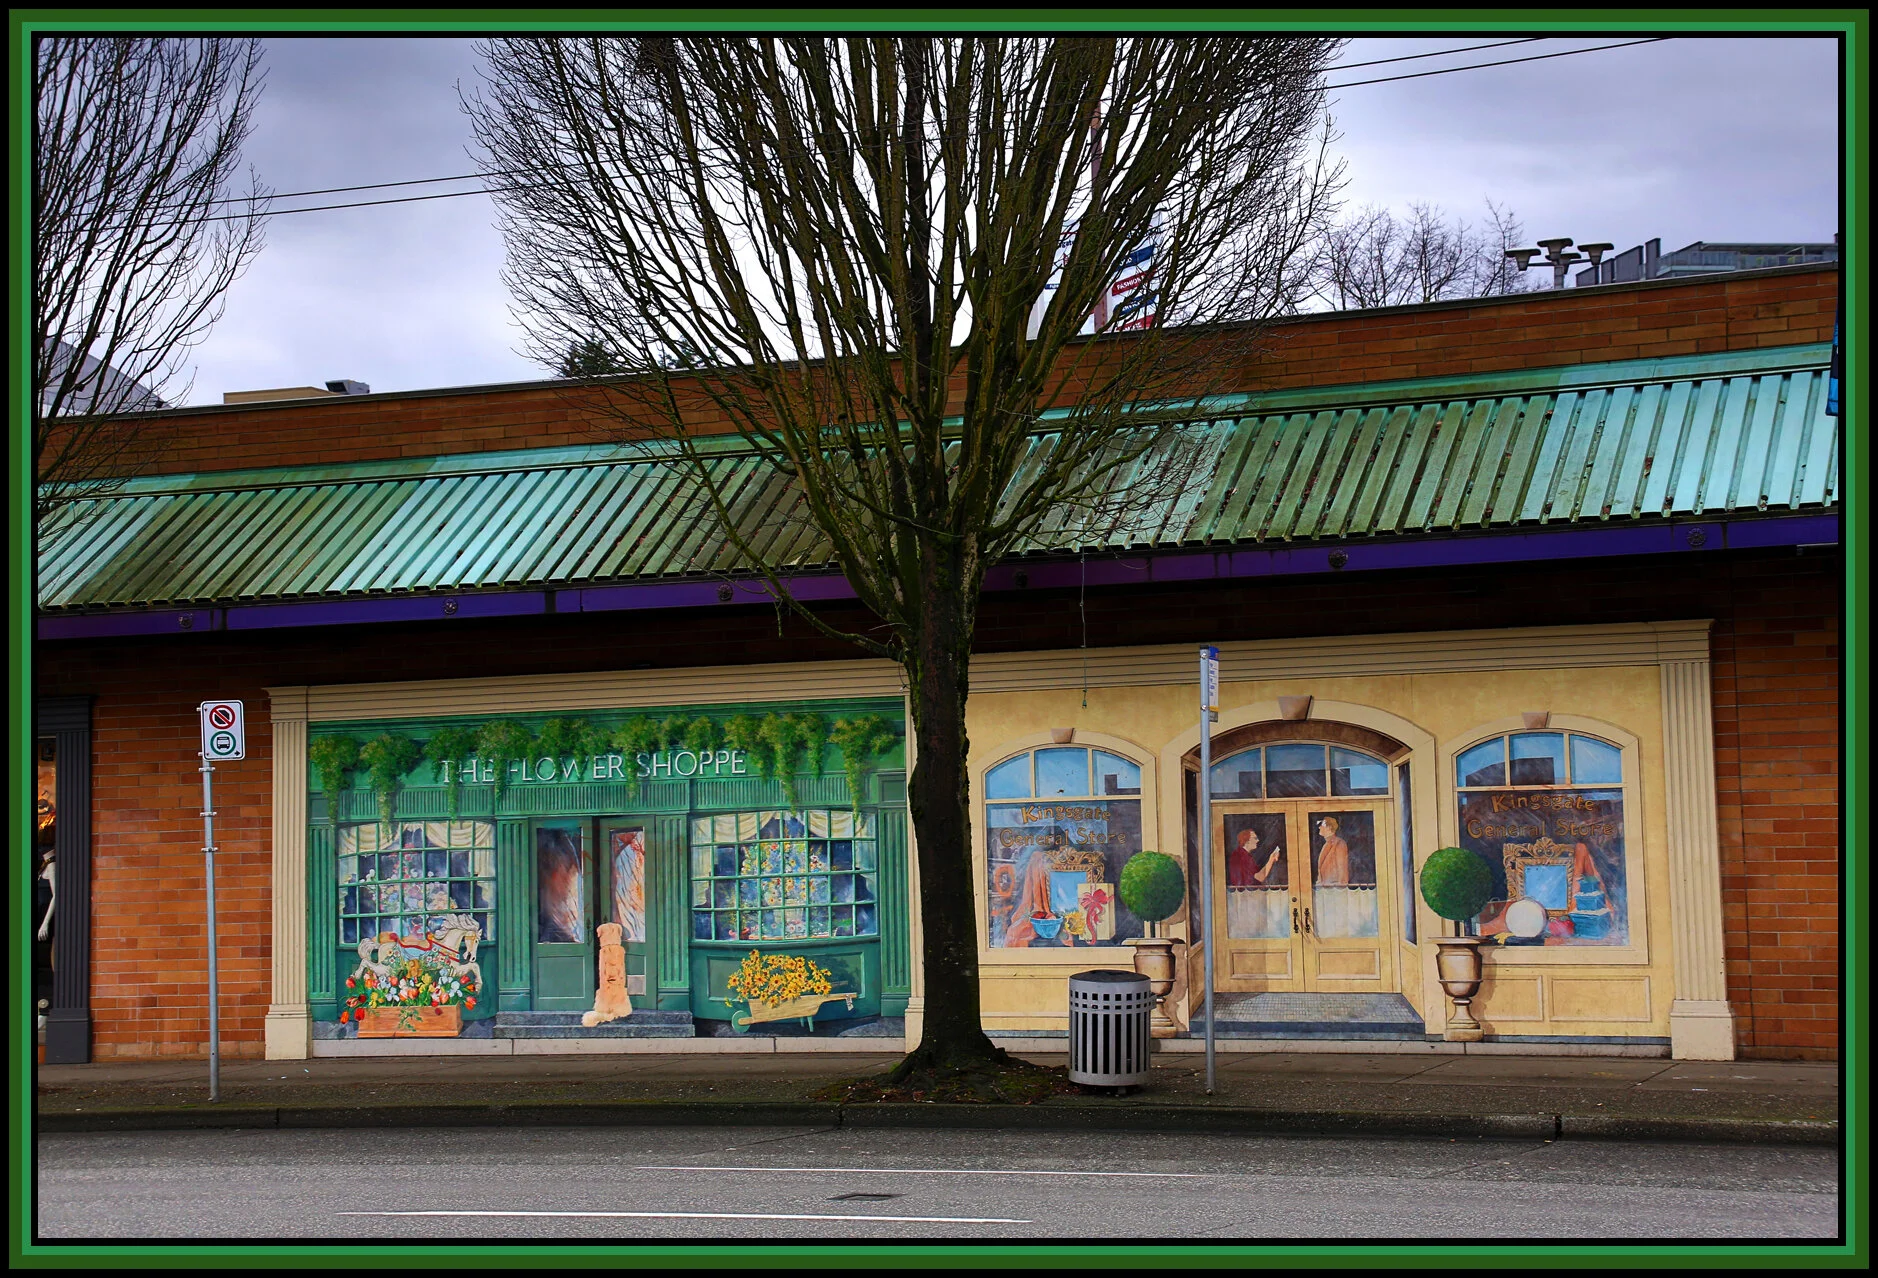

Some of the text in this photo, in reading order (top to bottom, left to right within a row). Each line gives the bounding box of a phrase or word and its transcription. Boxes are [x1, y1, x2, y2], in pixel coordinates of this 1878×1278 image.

[440, 750, 746, 783] THE FLOWER SHOPPE
[1491, 793, 1594, 814] Kingsgate
[1021, 805, 1111, 824] Kingsgate
[1000, 827, 1127, 847] General Store
[1467, 818, 1614, 839] General Store
